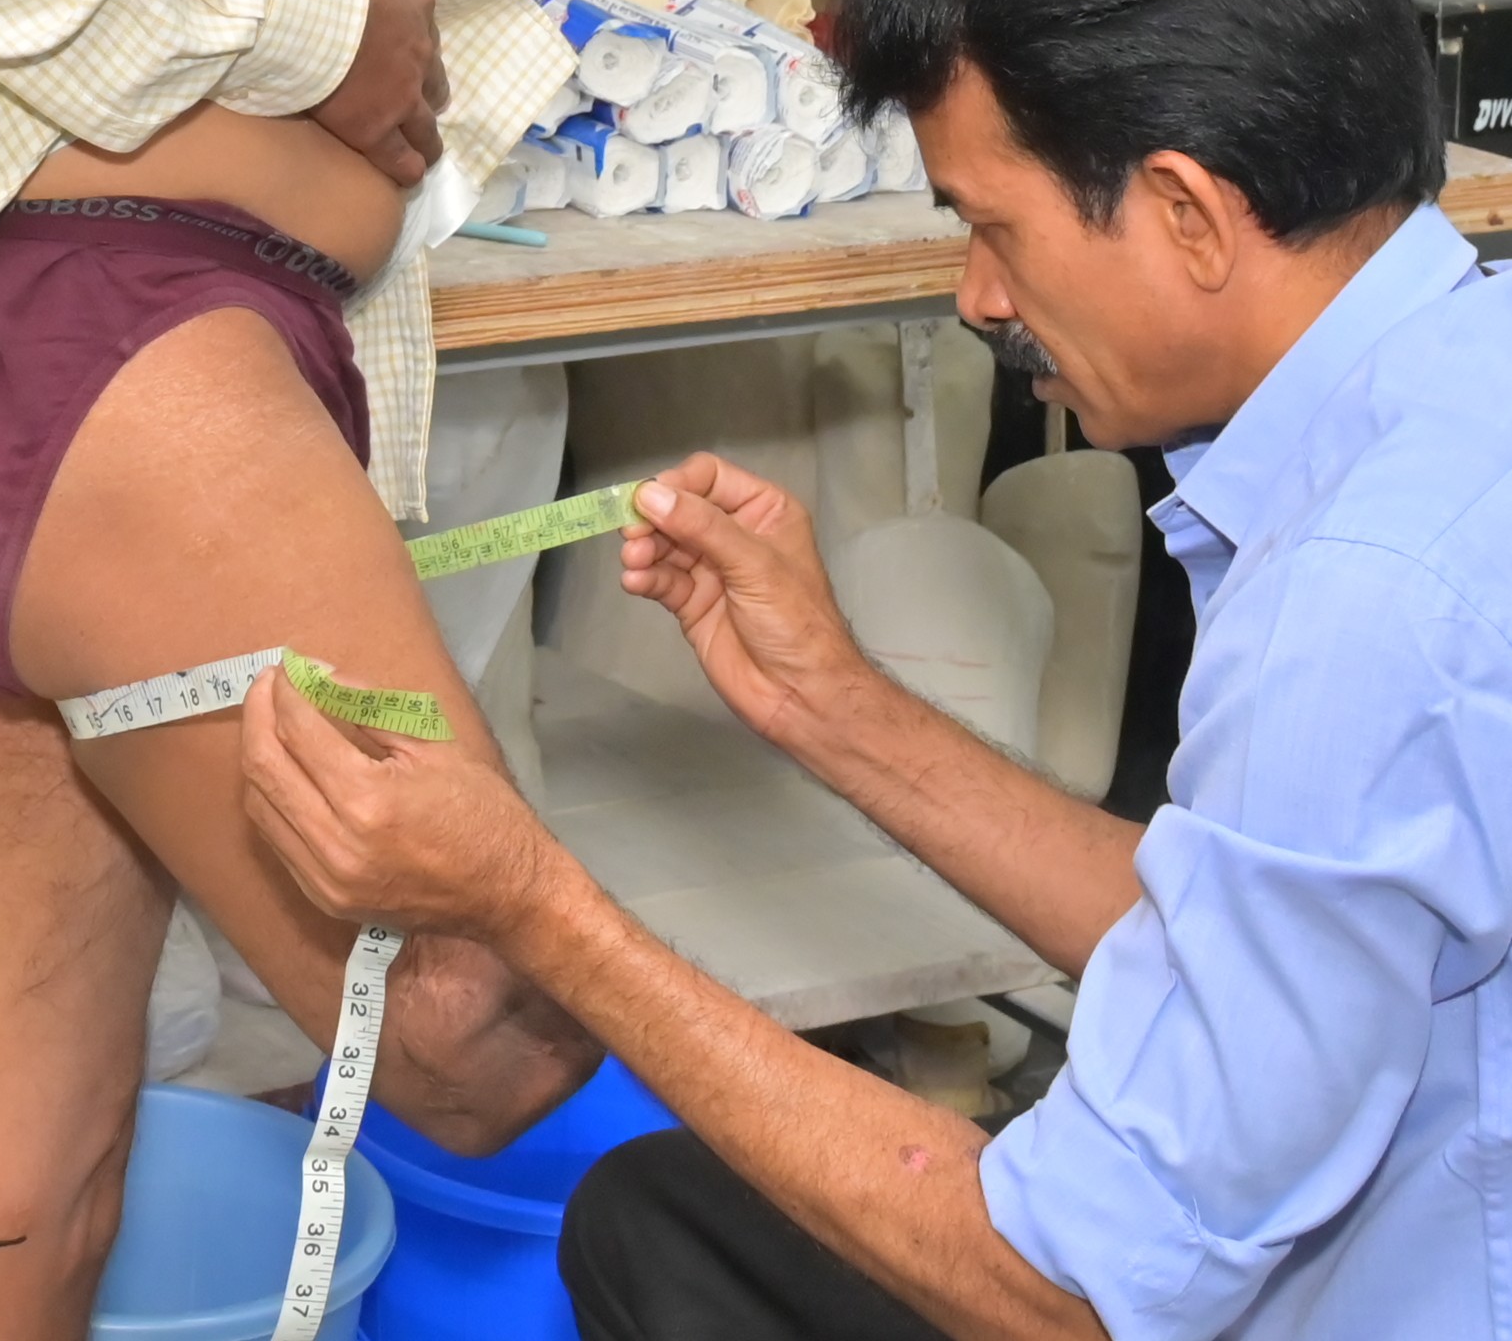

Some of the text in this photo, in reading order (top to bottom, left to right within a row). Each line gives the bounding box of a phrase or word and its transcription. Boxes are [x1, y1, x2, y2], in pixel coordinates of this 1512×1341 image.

[8, 197, 164, 222] GBOSS
[441, 538, 460, 553] 56
[492, 525, 512, 540] 57
[114, 704, 134, 724] 16
[146, 697, 164, 717] 17
[179, 687, 200, 710] 18
[212, 679, 232, 700] 19
[291, 926, 387, 1318] 31 32 33 34 35 36 37
